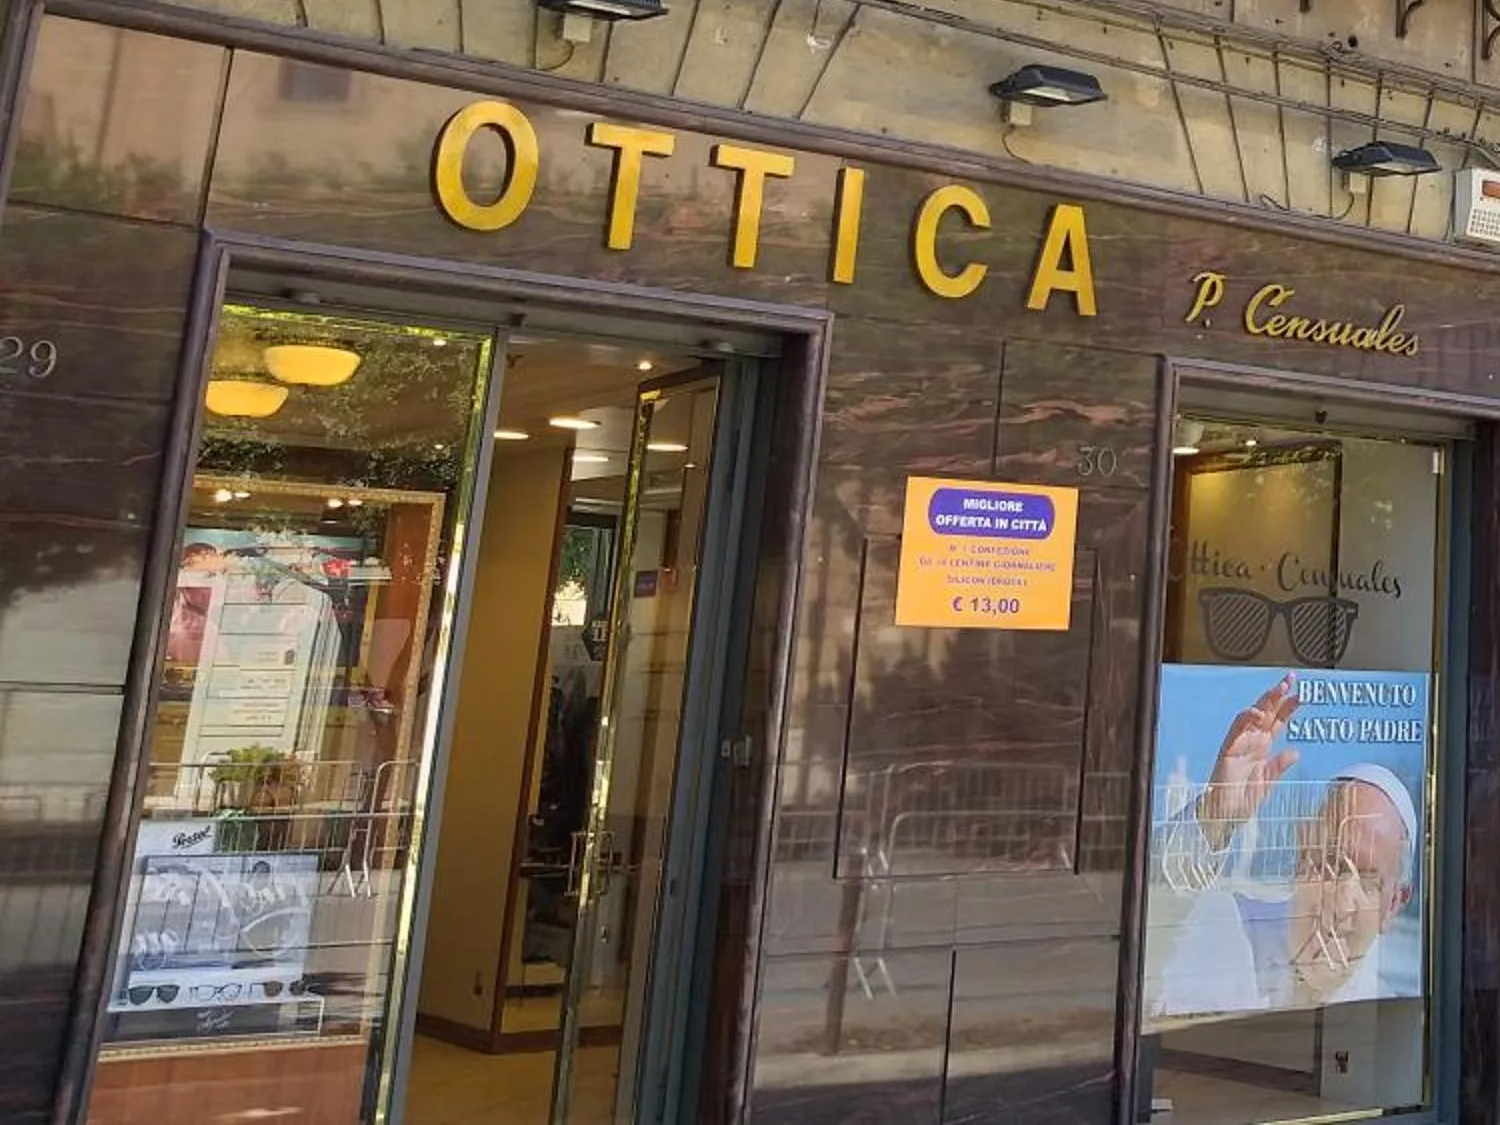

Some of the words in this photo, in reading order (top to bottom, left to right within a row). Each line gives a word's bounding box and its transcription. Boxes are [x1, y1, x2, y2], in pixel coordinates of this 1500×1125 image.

[434, 100, 1097, 316] OTTICA
[1245, 284, 1420, 356] Censuales
[0, 336, 57, 378] 29
[1078, 445, 1117, 477] 30
[963, 498, 1024, 512] MIGLIORE
[935, 516, 991, 529] OFFERTA
[995, 518, 1009, 529] IN
[1011, 517, 1047, 532] CITTÀ
[971, 597, 1020, 615] 13,00
[1299, 680, 1416, 707] BENVENUTO
[1287, 717, 1354, 743] SANTO
[1358, 719, 1423, 743] PADRE
